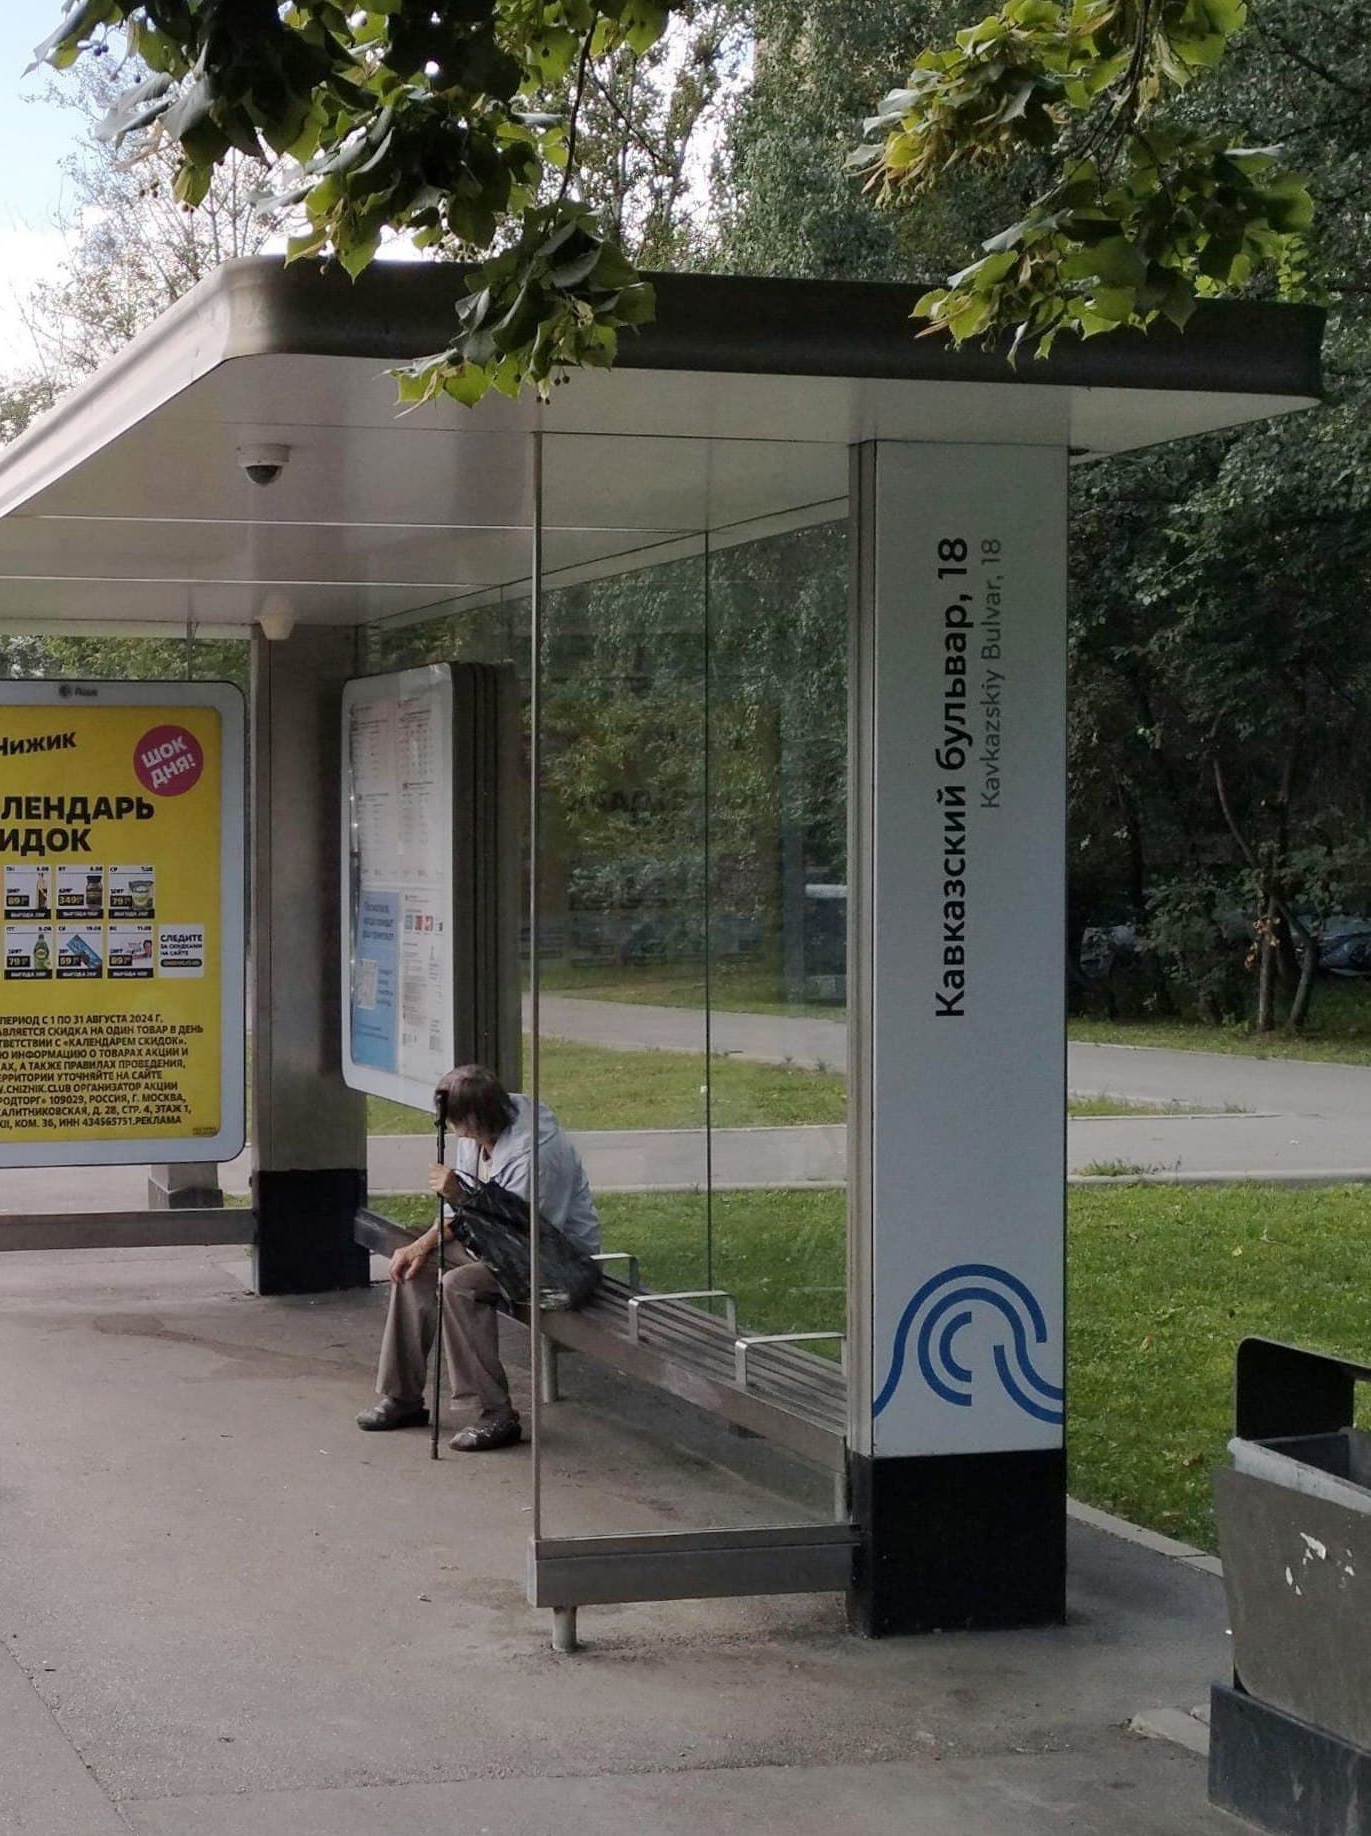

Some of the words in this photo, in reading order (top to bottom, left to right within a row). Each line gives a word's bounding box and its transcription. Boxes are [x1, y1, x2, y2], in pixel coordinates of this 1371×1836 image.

[980, 539, 1001, 566] 18
[937, 538, 967, 580] 18
[980, 575, 1004, 660] Bulvar,
[936, 594, 974, 770] бульвар,
[980, 669, 1006, 809] Kavkazskiy
[141, 735, 188, 768] ШОК
[150, 753, 196, 789] ДНЯ!
[936, 786, 966, 1017] Кавказский
[160, 934, 202, 943] СЛЕДИТЕ
[0, 1016, 40, 1026] ПЕРИОД
[42, 1016, 48, 1024] С
[50, 1016, 55, 1024] 1
[57, 1015, 71, 1024] ПО
[74, 1015, 83, 1024] 31
[87, 1015, 128, 1024] АВГУСТА
[129, 1014, 153, 1023] 2024
[155, 1014, 163, 1023] Г.
[48, 1026, 88, 1037] СКИДКА
[90, 1026, 103, 1035] НА
[106, 1026, 134, 1036] ОДИН
[137, 1025, 167, 1034] ТОВАР
[170, 1025, 176, 1033] В
[178, 1024, 203, 1035] ДЕНЬ
[55, 1039, 61, 1047] С
[63, 1037, 136, 1047] «КАЛЕНДАРЕМ
[11, 1049, 87, 1059] ИНФОРМАЦИЮ
[89, 1049, 97, 1057] О
[99, 1048, 143, 1057] ТОВАРАХ
[145, 1047, 179, 1057] АКЦИИ
[181, 1047, 188, 1056] И
[19, 1062, 26, 1070] А
[28, 1061, 62, 1070] ТАКЖЕ
[63, 1060, 116, 1069] ПРАВИЛАХ
[118, 1059, 186, 1069] ПРОВЕДЕНИЯ,
[57, 1070, 114, 1081] УТОЧНЯЙТЕ
[116, 1072, 129, 1080] НА
[131, 1069, 163, 1080] САЙТЕ
[73, 1082, 141, 1092] ОРГАНИЗАТОР
[143, 1081, 178, 1091] АКЦИИ
[49, 1095, 87, 1104] 109029,
[89, 1094, 130, 1104] РОССИЯ,
[142, 1093, 187, 1103] МОСКВА,
[93, 1106, 103, 1115] Д.
[105, 1106, 120, 1115] 28,
[122, 1105, 141, 1114] СТР.
[155, 1105, 182, 1114] ЭТАЖ
[14, 1119, 40, 1128] КОМ.
[59, 1117, 80, 1127] ИНН
